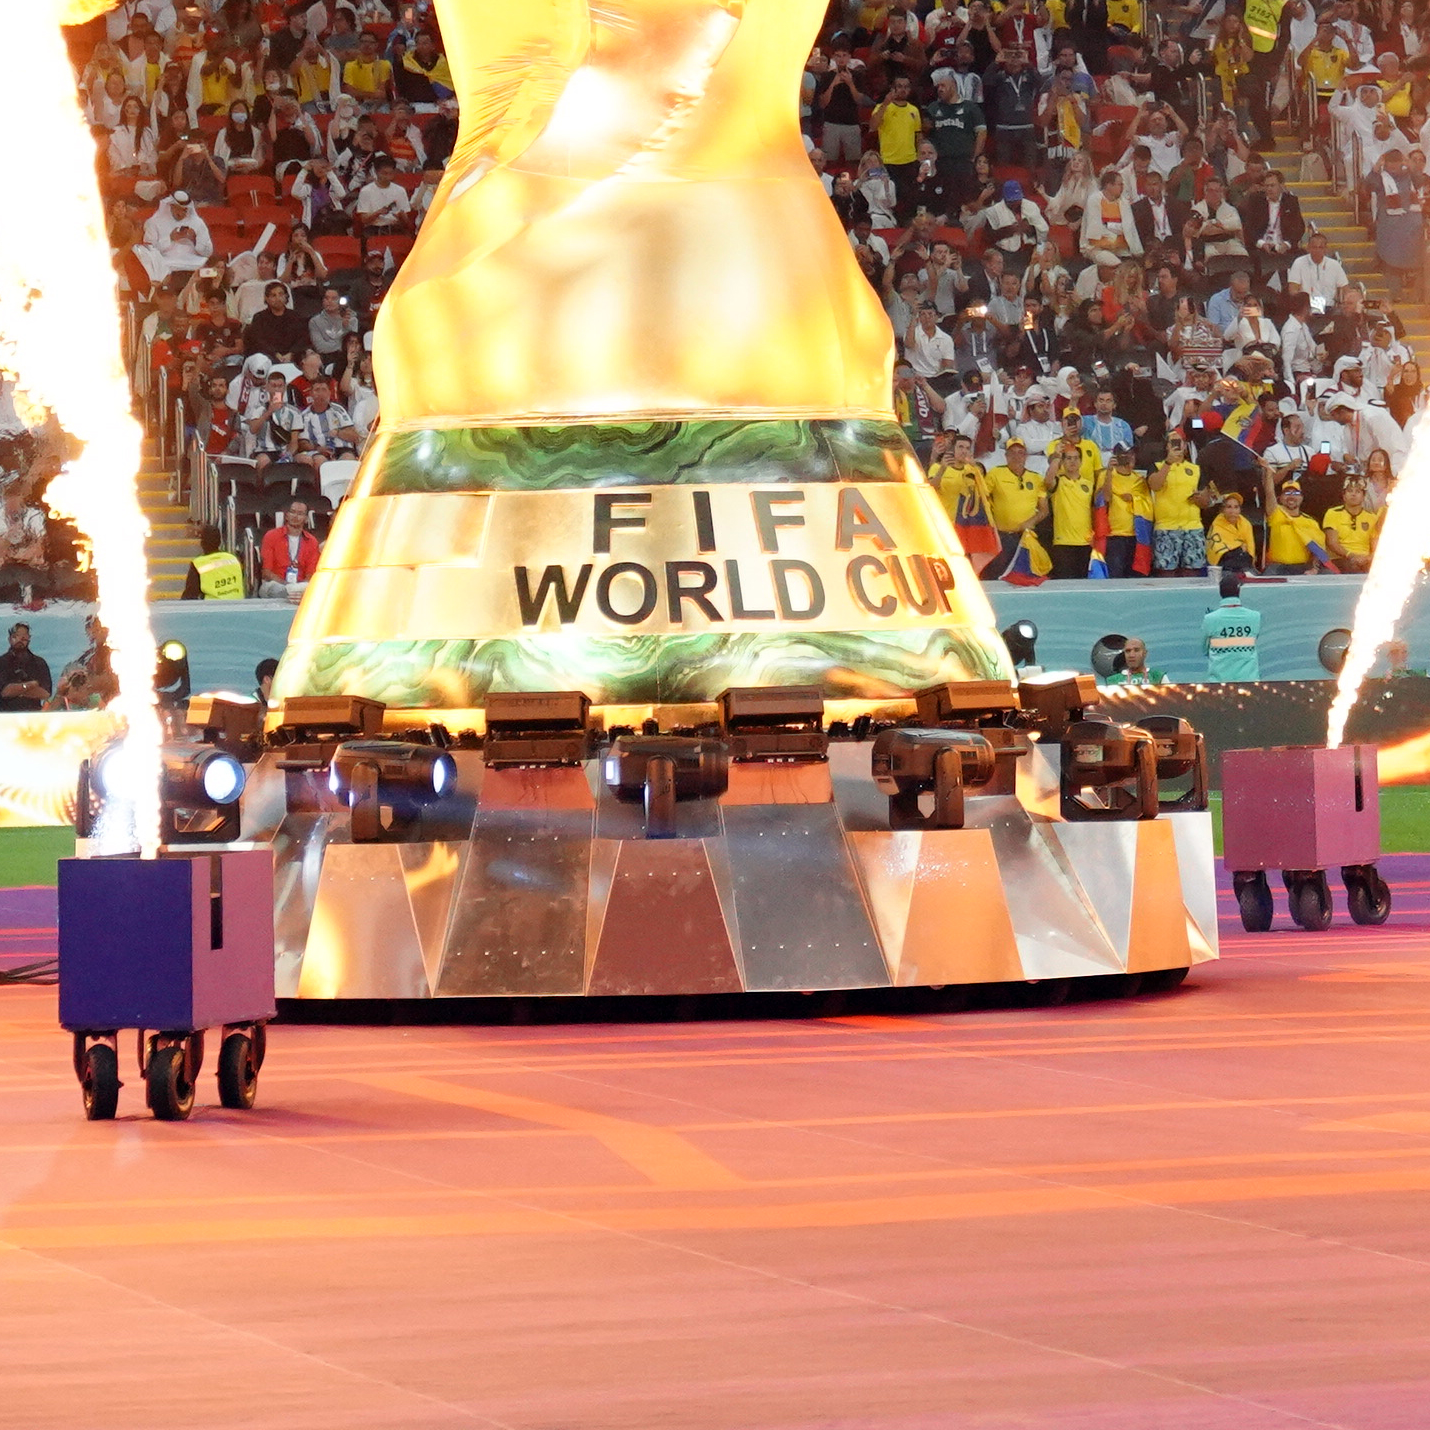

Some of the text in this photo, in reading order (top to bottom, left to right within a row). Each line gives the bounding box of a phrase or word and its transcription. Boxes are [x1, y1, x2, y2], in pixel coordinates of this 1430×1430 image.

[592, 486, 898, 555] FIFA
[215, 575, 237, 588] 2921
[513, 554, 956, 626] WORLD CUP
[1220, 625, 1252, 638] 4289
